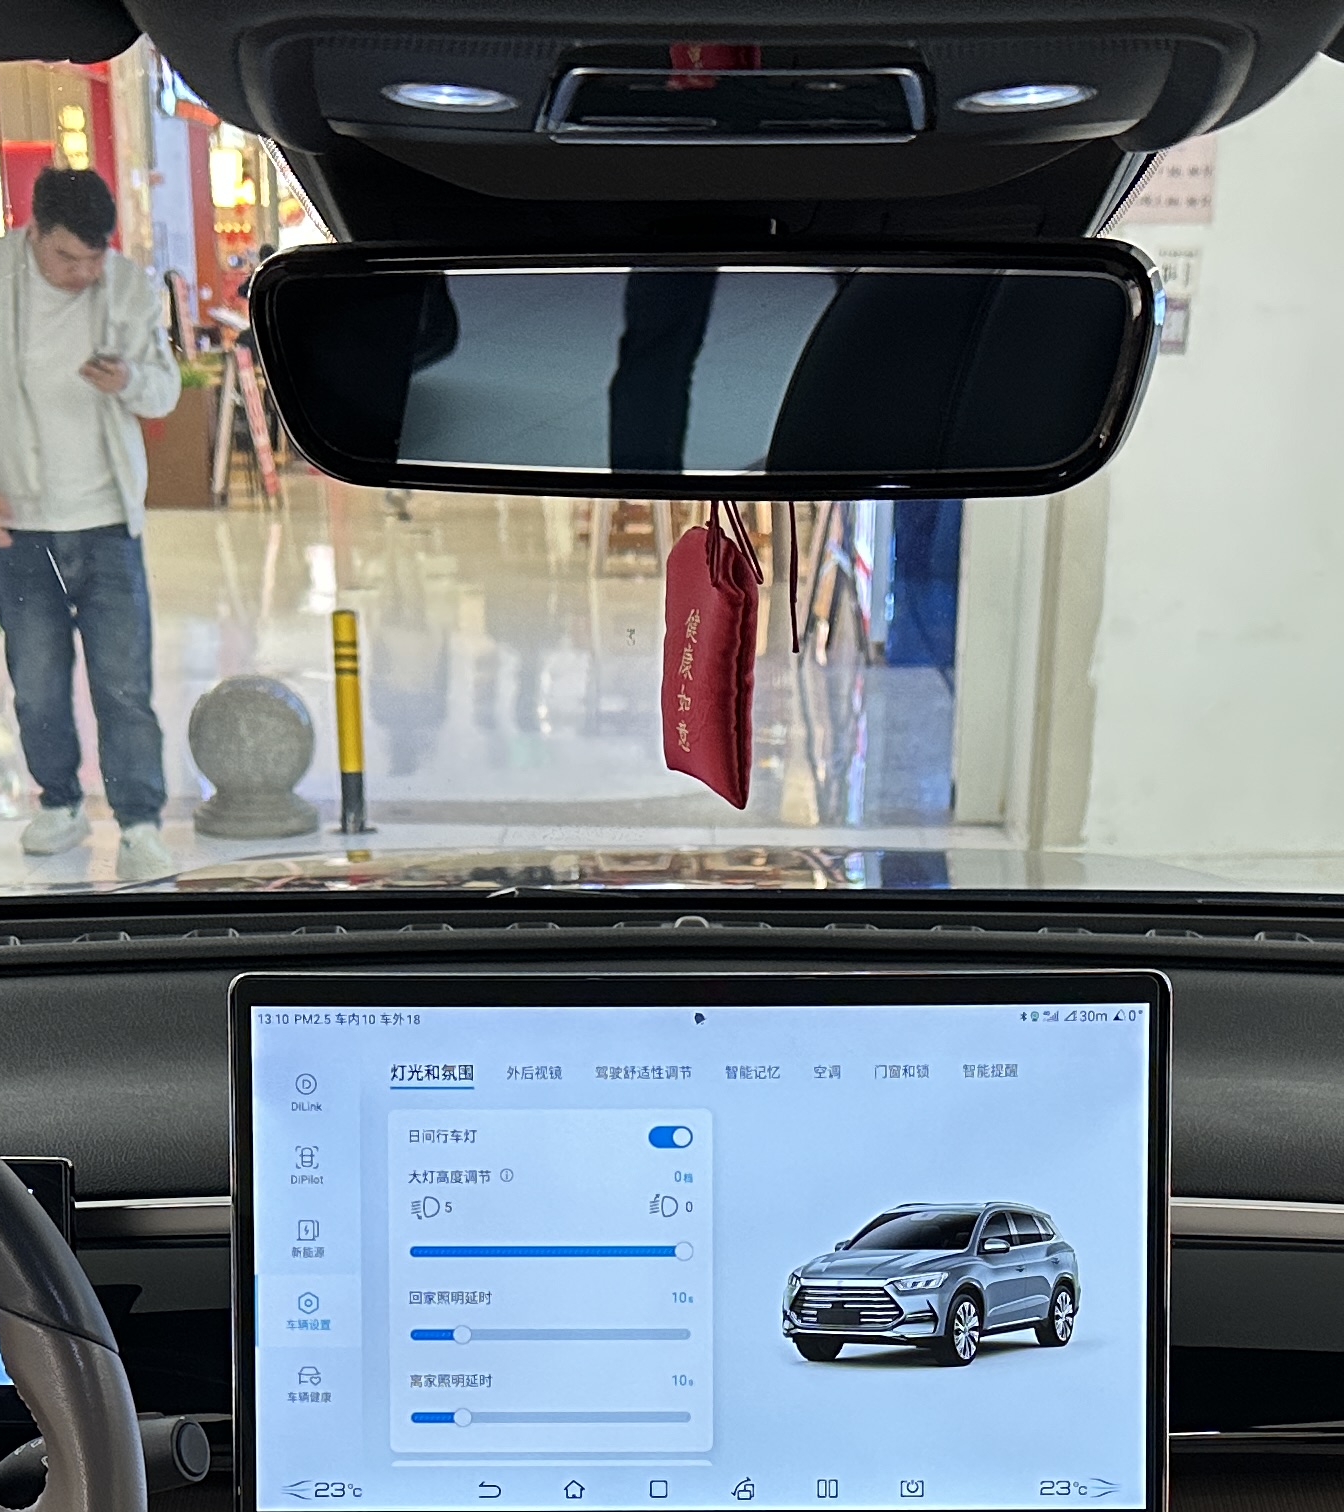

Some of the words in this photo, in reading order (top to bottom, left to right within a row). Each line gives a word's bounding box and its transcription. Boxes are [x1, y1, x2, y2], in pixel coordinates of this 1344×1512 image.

[294, 1013, 331, 1025] PM2.5
[335, 1012, 375, 1026] 车内10
[380, 1012, 420, 1026] 车外18
[1079, 1010, 1108, 1022] 30m
[390, 1063, 474, 1082] 灯光和氛围
[506, 1065, 562, 1081] 外后视镜
[595, 1065, 692, 1081] 驾驶舒适性调节
[725, 1064, 780, 1080] 智能记忆
[813, 1064, 841, 1080] 空调
[874, 1063, 929, 1080] 门窗和锁
[962, 1063, 1018, 1079] 智能提醒
[409, 1129, 477, 1144] 日间行车灯
[408, 1169, 491, 1185] 大灯高度调节
[444, 1201, 453, 1214] 5
[685, 1201, 693, 1214] 0
[291, 1246, 325, 1259] 新能源
[409, 1290, 492, 1306] 回家照明延时
[286, 1318, 331, 1331] 车辆设置
[409, 1373, 492, 1389] 离家照明延时
[287, 1391, 331, 1404] 车辆健康
